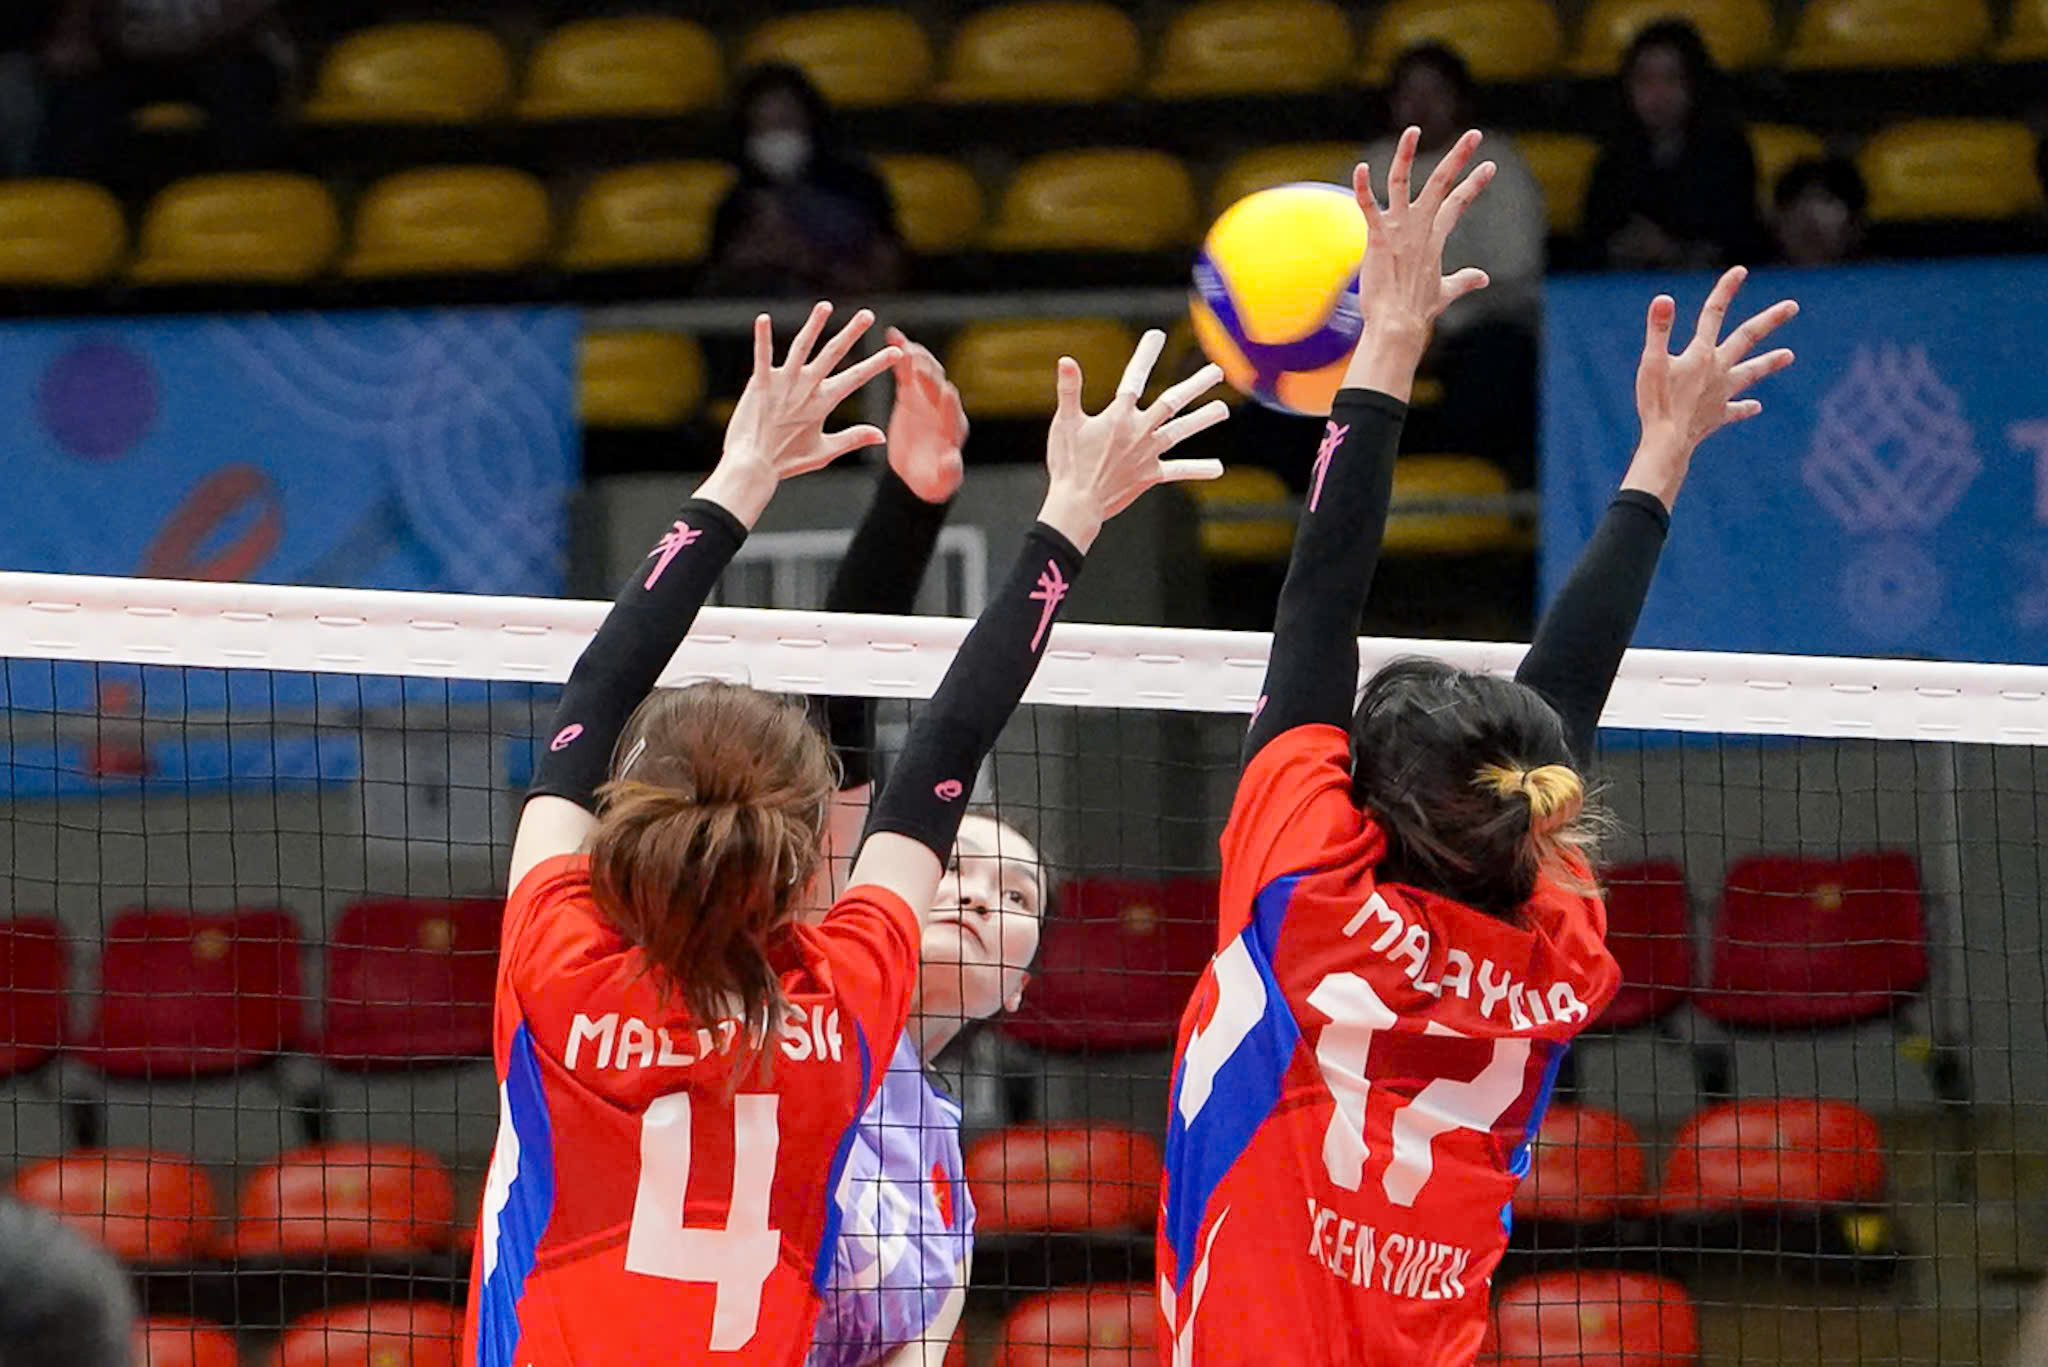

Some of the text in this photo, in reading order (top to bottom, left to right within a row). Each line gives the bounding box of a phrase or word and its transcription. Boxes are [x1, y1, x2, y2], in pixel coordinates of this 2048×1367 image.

[564, 1003, 843, 1071] MALSI
[1306, 971, 1532, 1208] 17
[625, 1091, 781, 1352] 4
